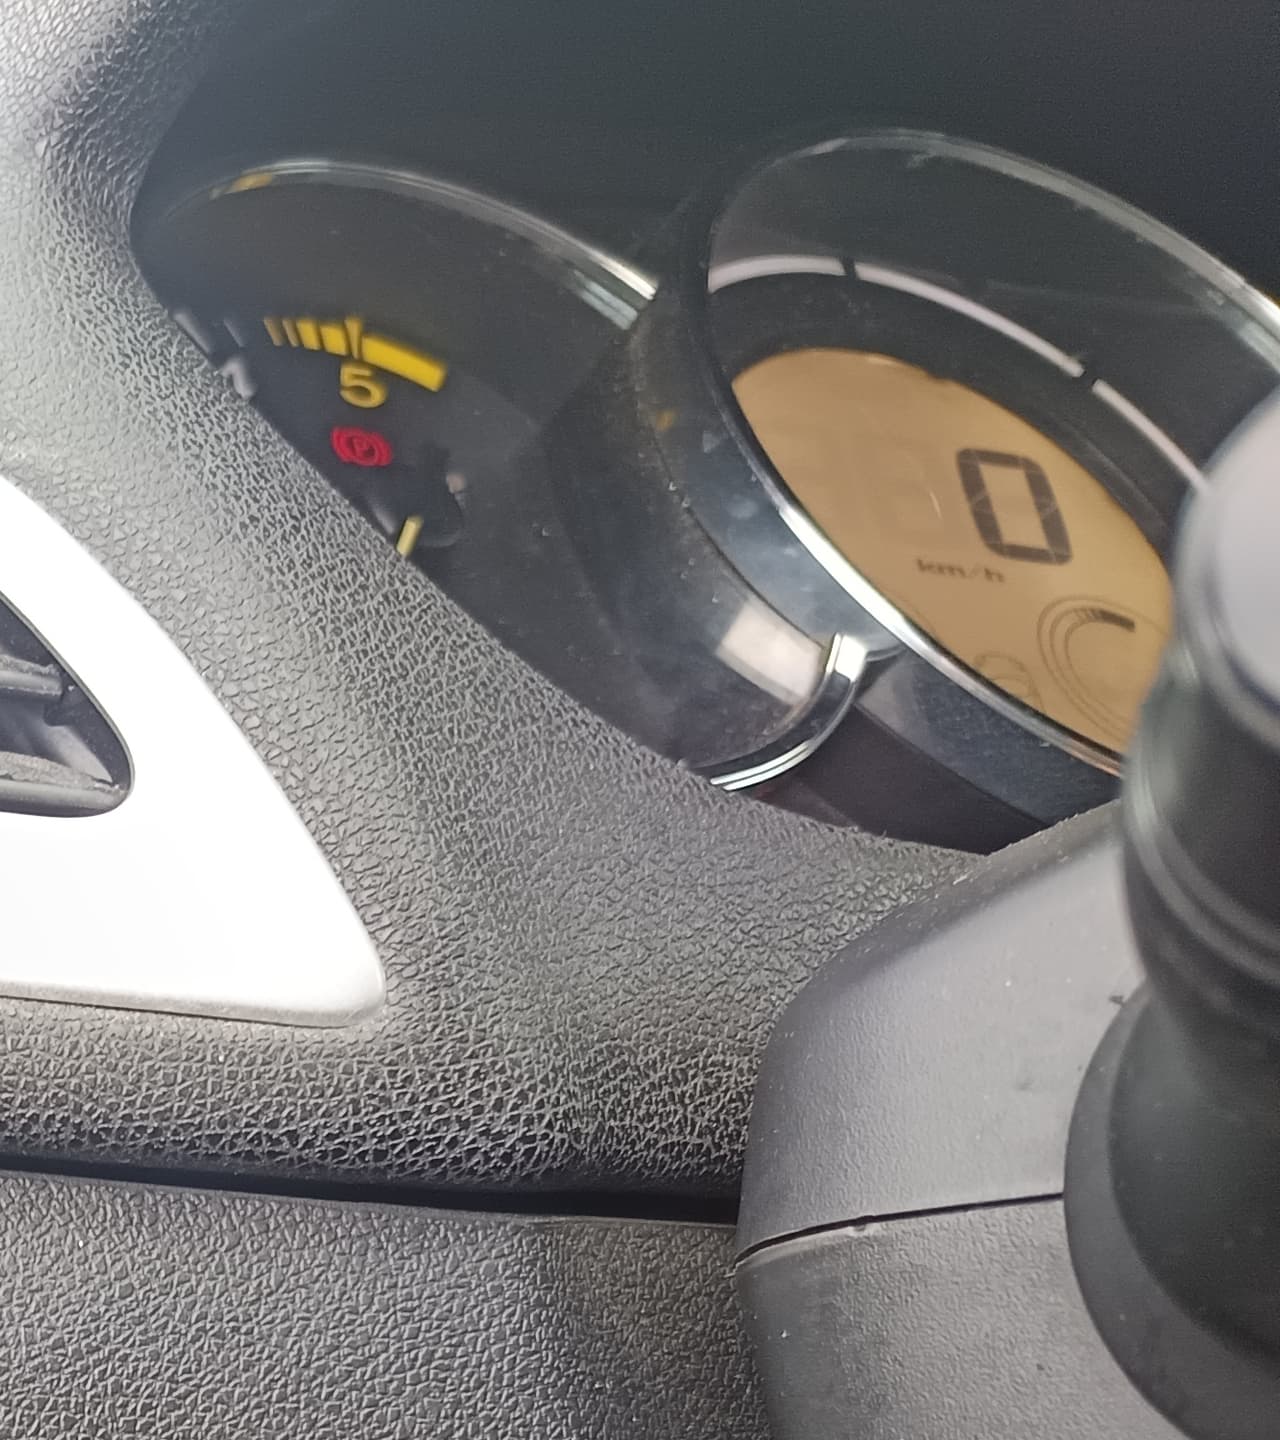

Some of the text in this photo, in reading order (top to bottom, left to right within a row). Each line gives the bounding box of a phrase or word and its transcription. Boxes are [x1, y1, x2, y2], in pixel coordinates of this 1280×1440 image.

[339, 362, 388, 409] 5
[956, 448, 1072, 566] 0
[916, 557, 1006, 583] km/h
